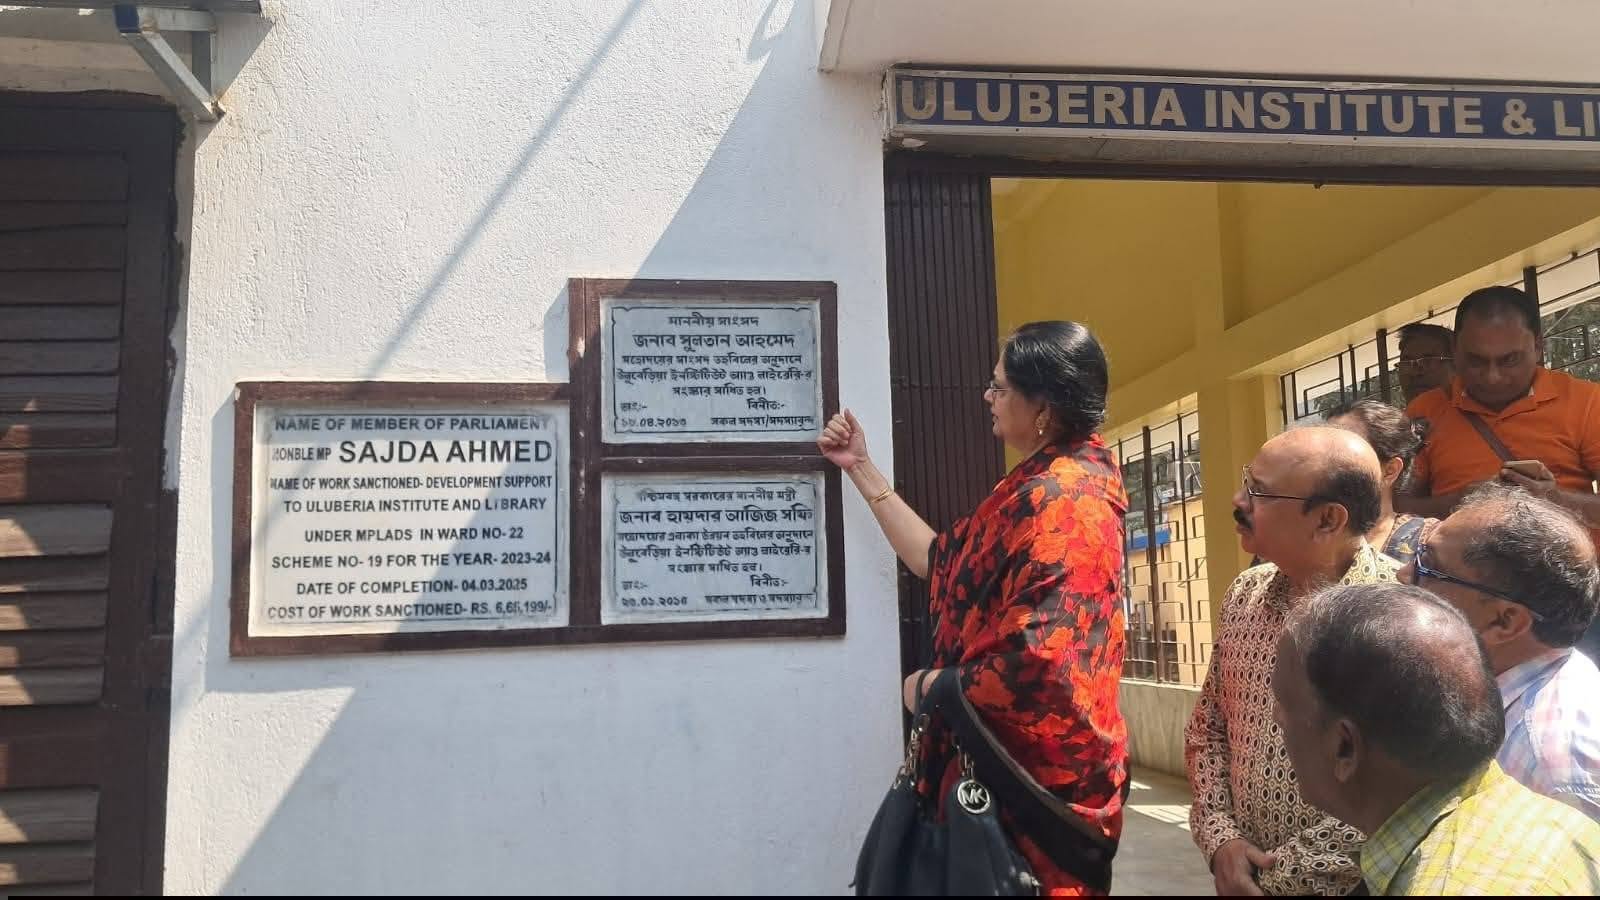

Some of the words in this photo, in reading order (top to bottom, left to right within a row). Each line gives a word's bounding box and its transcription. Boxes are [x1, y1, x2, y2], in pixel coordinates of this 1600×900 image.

[901, 79, 1187, 127] ULUBERIA
[1204, 89, 1484, 134] INSTITUTE
[1502, 98, 1536, 135] &
[1552, 100, 1600, 137] LI
[668, 312, 715, 327] মাননীয়
[718, 316, 760, 327] সাংসদ
[632, 334, 676, 348] জনাব
[735, 334, 795, 349] আহমেদ
[676, 355, 710, 365] সাংসদ
[275, 418, 320, 431] NAME
[325, 418, 346, 431] OF
[351, 418, 420, 431] MEMBER
[424, 417, 445, 430] OF
[450, 417, 550, 431] PARLIAMENT
[317, 447, 332, 461] MP
[339, 440, 438, 463] SAJDA
[445, 440, 552, 463] AHMED
[270, 477, 300, 490] NAME
[302, 477, 316, 490] OF
[319, 477, 351, 490] WORK
[353, 476, 424, 490] SANCTIONED-
[426, 475, 502, 489] DEVELOPMENT
[504, 475, 552, 489] SUPPORT
[737, 487, 774, 502] মাননীয়
[284, 500, 301, 513] TO
[306, 499, 375, 513] ULUBERIA
[379, 499, 449, 512] INSTITUTE
[452, 498, 481, 511] AND
[619, 511, 662, 524] জনাব
[667, 510, 721, 523] হায়দার
[725, 504, 777, 523] আজিজ
[304, 528, 352, 542] UNDER
[356, 528, 413, 542] MPLADS
[420, 528, 434, 541] IN
[438, 527, 478, 541] WARD
[482, 527, 507, 540] NO-
[508, 527, 524, 539] 22
[272, 556, 333, 569] SCHEME
[337, 555, 364, 569] NO-
[368, 555, 382, 568] 19
[386, 554, 417, 567] FOR
[421, 553, 449, 567] THE
[451, 552, 498, 566] YEAR-
[501, 551, 552, 565] 2023-24
[296, 582, 333, 596] DATE
[337, 581, 355, 595] OF
[360, 580, 459, 595] COMPLETION-
[461, 578, 528, 592] 04.03.2025
[268, 606, 304, 620] COST
[308, 605, 326, 619] OF
[330, 604, 371, 618] WORK
[375, 602, 467, 617] SANCTIONED-
[961, 787, 987, 805] MK
